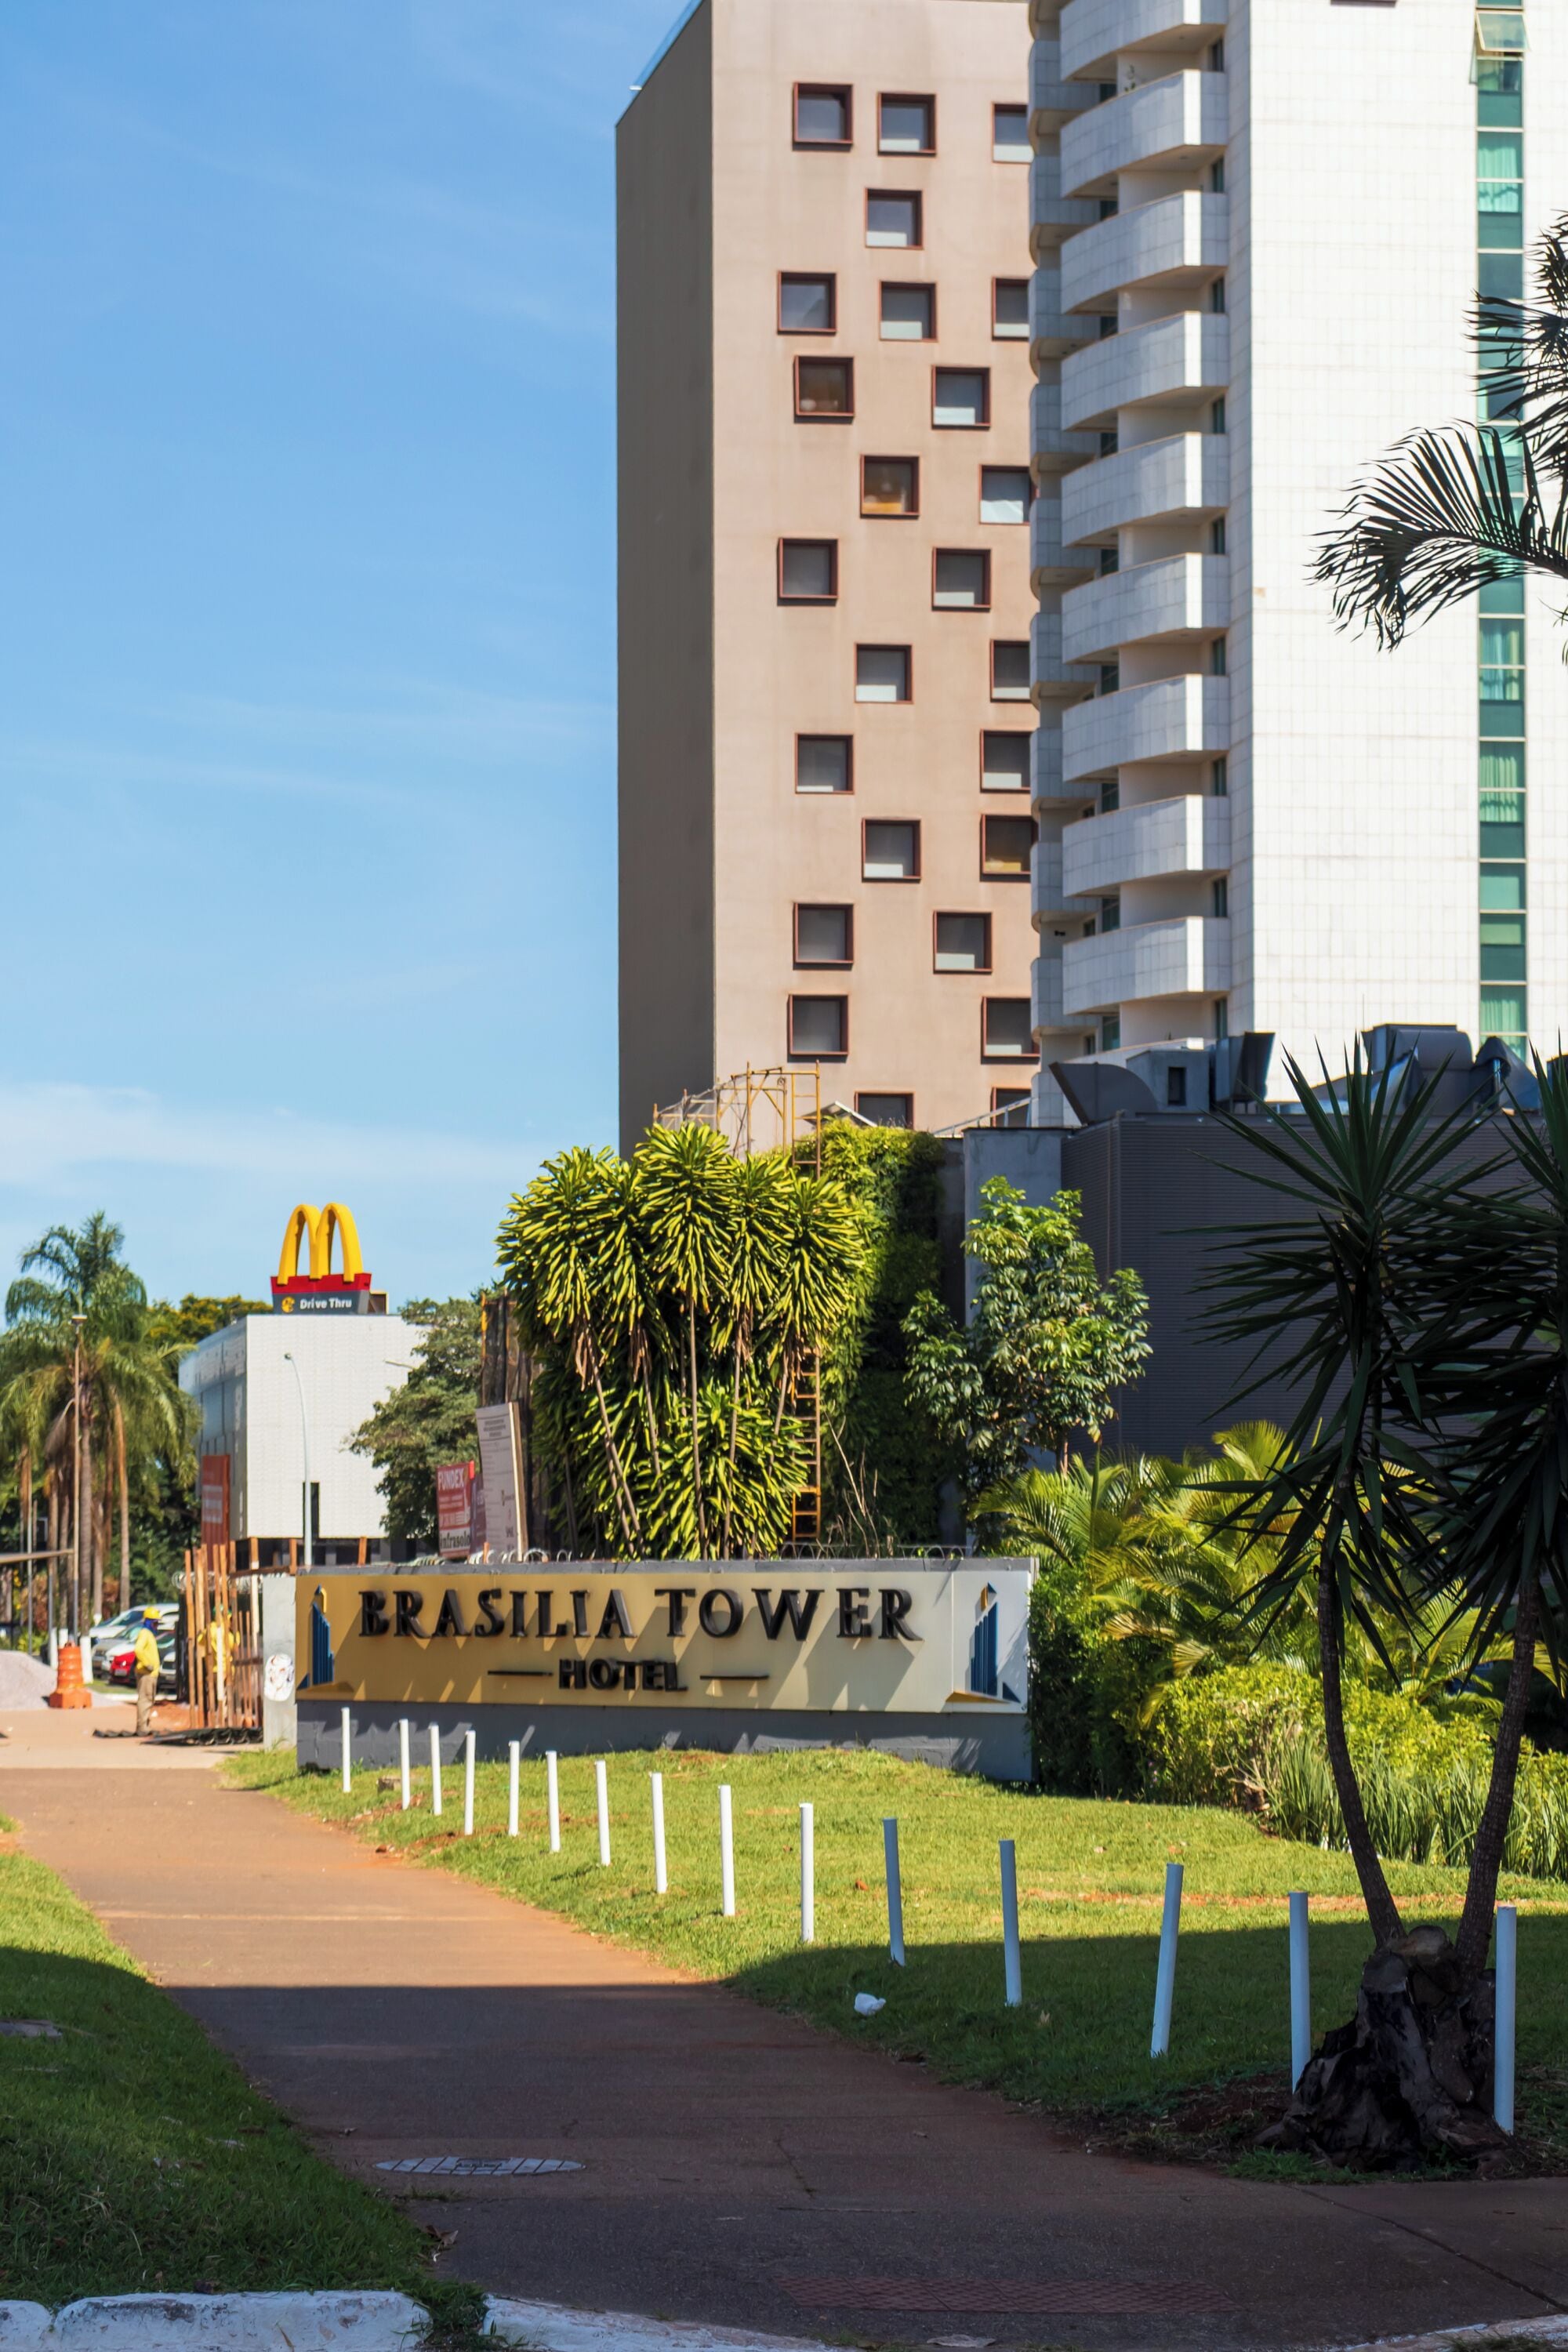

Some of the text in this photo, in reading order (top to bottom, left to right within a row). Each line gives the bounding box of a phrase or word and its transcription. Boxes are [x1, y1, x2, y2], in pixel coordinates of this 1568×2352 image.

[299, 1297, 352, 1309] Drive Thru
[358, 1588, 924, 1642] BRASILIA TOWER
[558, 1657, 688, 1693] HOTEL
